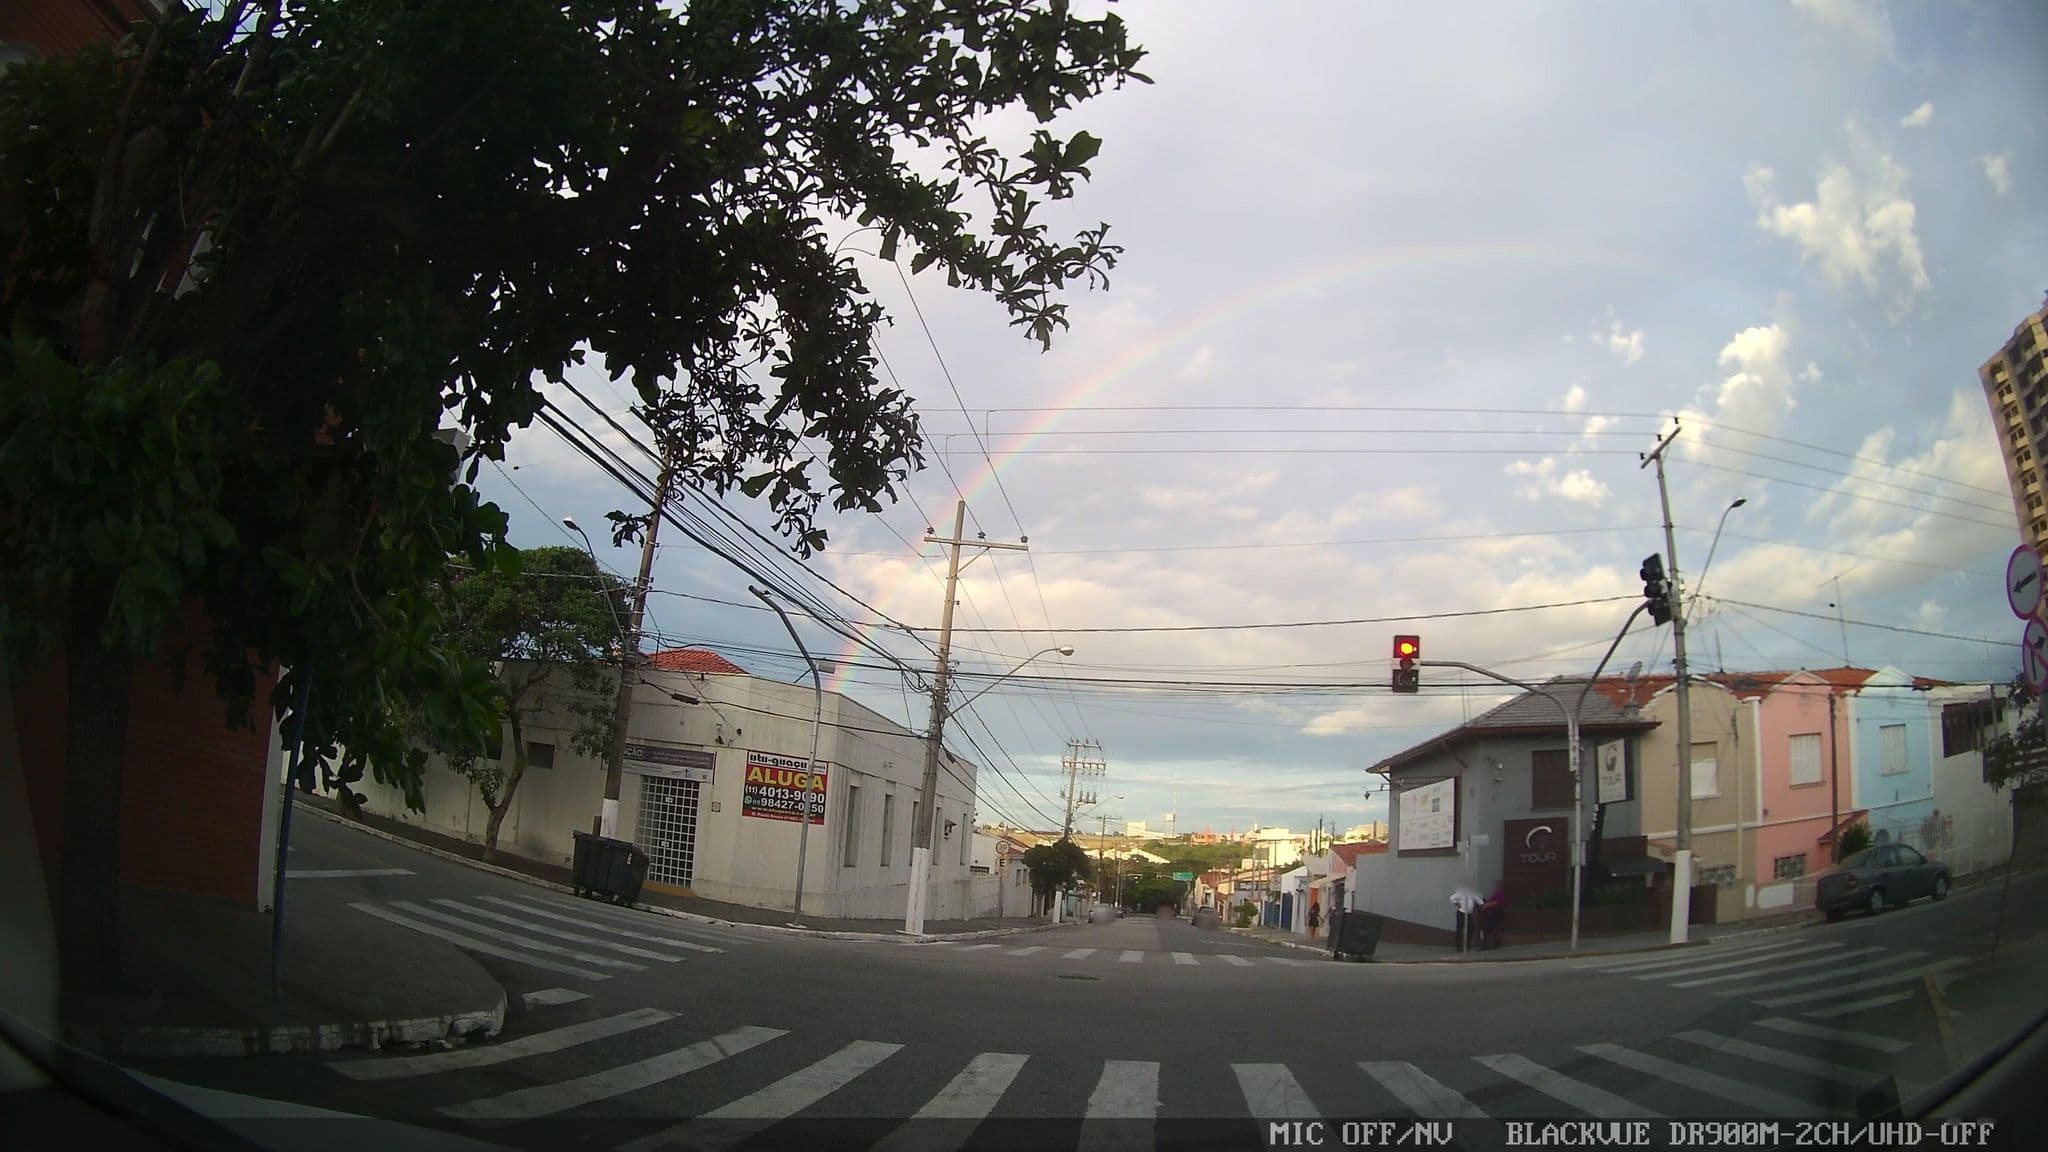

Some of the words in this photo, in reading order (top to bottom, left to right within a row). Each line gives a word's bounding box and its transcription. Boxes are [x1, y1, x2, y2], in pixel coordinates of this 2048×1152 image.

[747, 766, 824, 791] ALUGA
[761, 798, 824, 813] 98427-050
[999, 858, 1005, 867] E
[1520, 852, 1557, 864] TOUR
